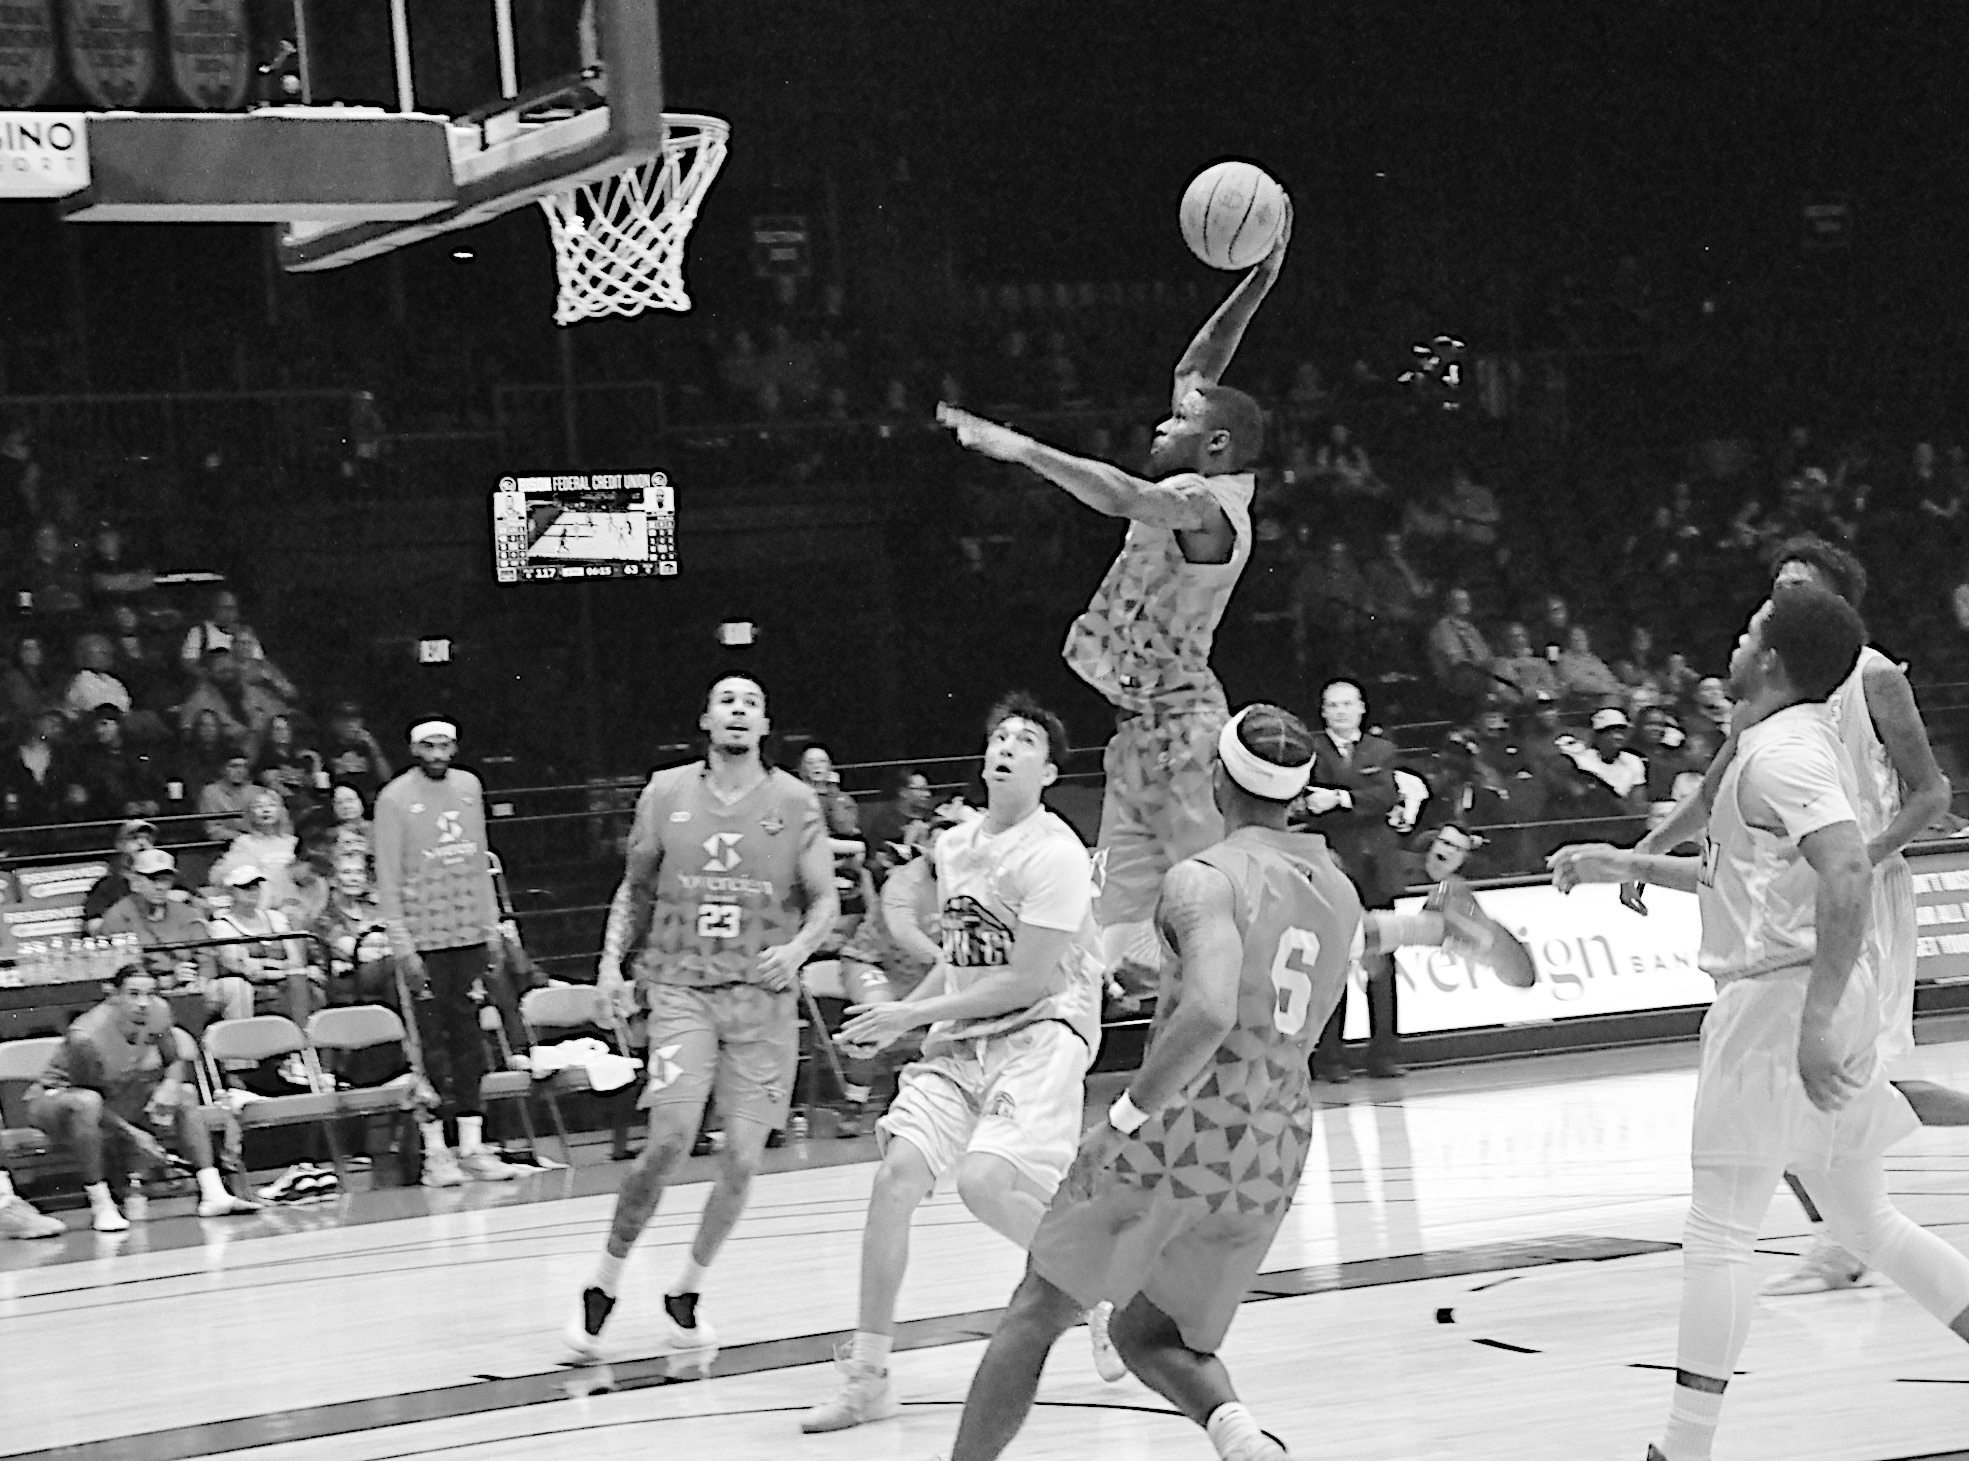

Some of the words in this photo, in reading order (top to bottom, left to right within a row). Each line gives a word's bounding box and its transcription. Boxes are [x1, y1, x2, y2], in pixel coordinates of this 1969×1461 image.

[552, 475, 591, 492] FEDERAL
[591, 474, 622, 490] CREDIT
[623, 473, 650, 490] UNION
[535, 567, 556, 579] 117
[624, 564, 639, 575] 63
[698, 903, 742, 938] 23
[1394, 925, 1619, 1001] verign
[1630, 949, 1698, 974] BAN
[1271, 926, 1320, 1036] 6
